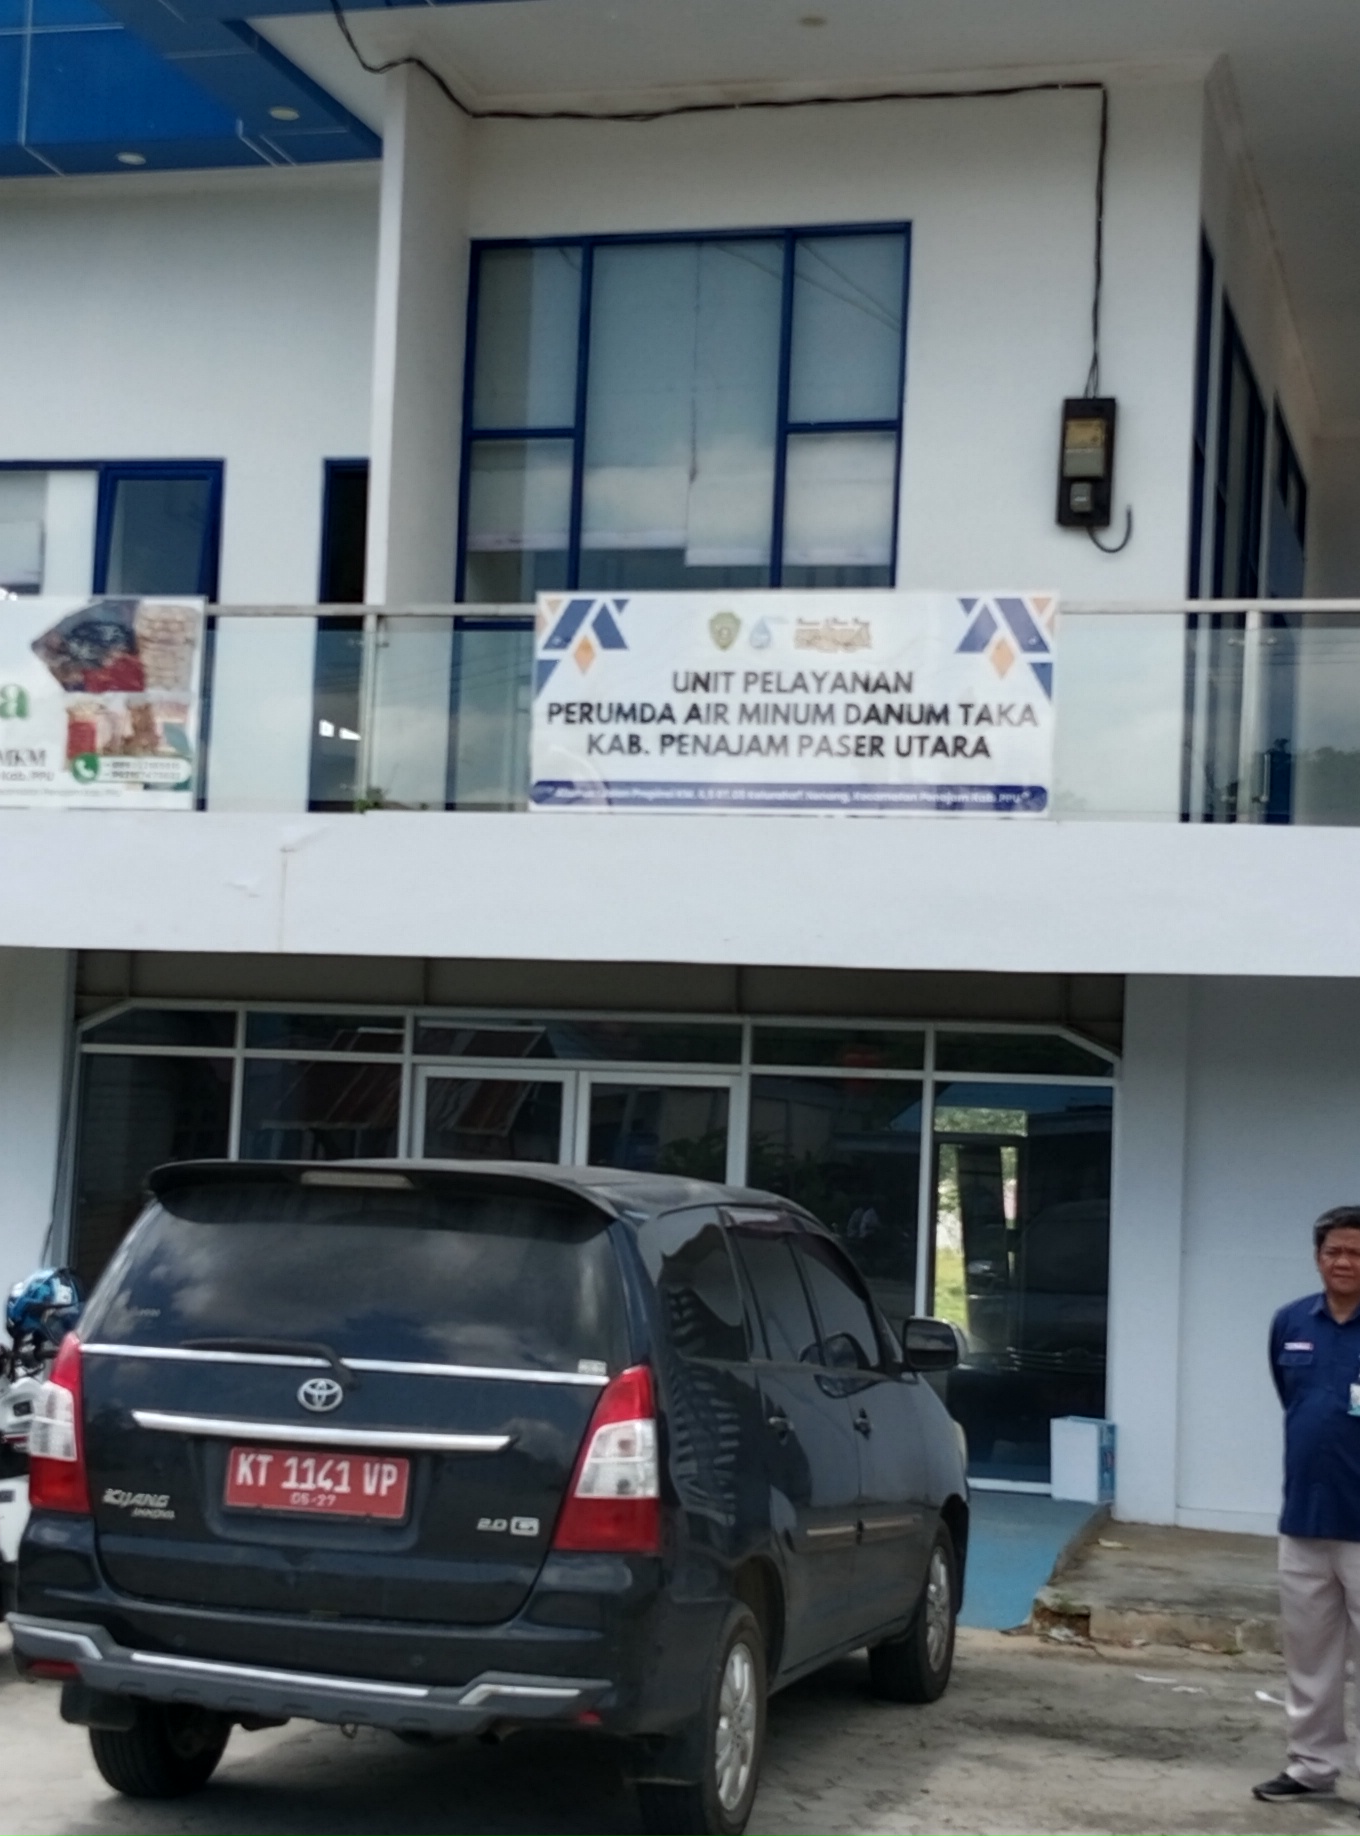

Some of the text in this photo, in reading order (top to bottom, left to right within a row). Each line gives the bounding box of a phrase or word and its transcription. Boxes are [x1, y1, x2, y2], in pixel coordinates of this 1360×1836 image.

[672, 670, 915, 695] UNIT PELAYANAN
[547, 702, 1038, 728] PERUMDA AIR MINUM DANUM TAKA
[586, 733, 992, 759] KAB. PENAJAM PASER UTARA
[235, 1453, 399, 1497] KT 1141 VP
